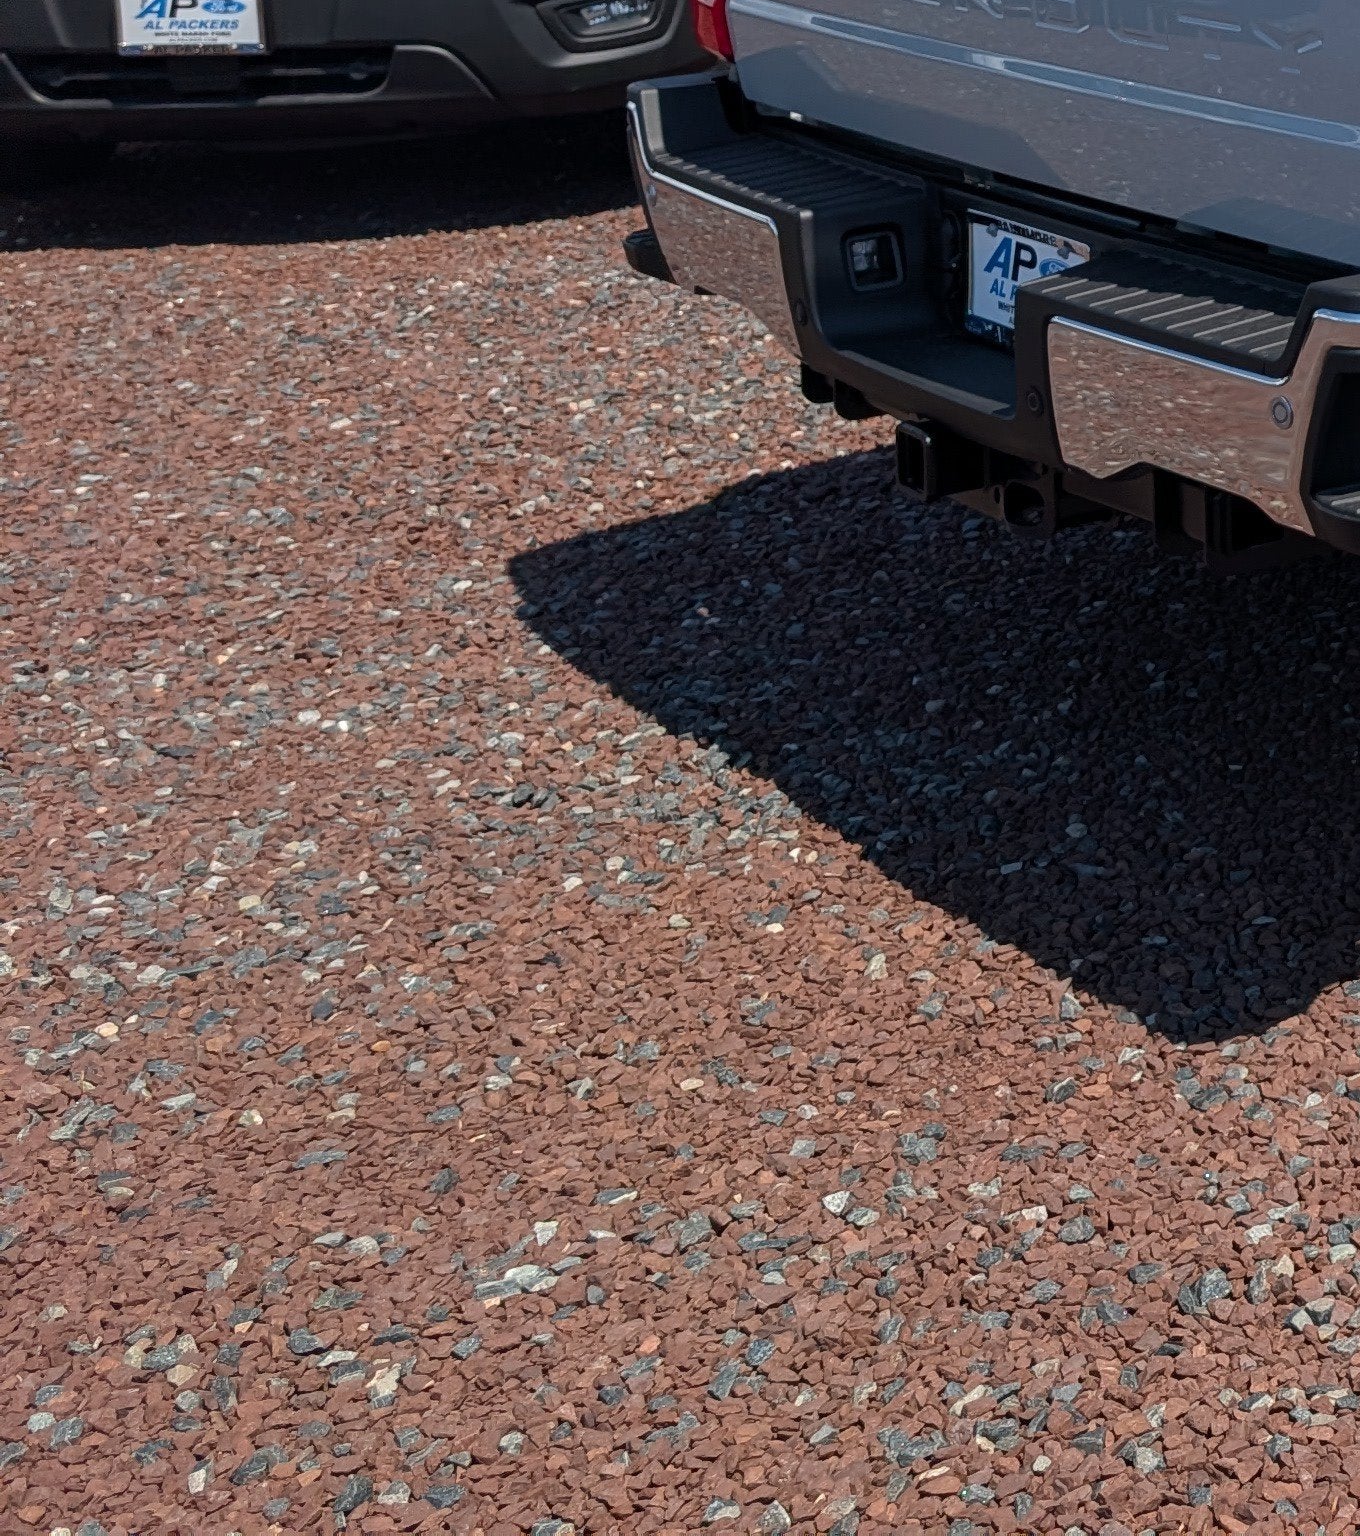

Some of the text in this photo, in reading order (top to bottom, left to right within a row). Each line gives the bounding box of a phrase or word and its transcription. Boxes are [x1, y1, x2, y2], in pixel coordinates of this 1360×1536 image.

[143, 19, 239, 31] AL PACKERS
[983, 236, 1037, 282] AP
[989, 278, 1006, 298] AL
